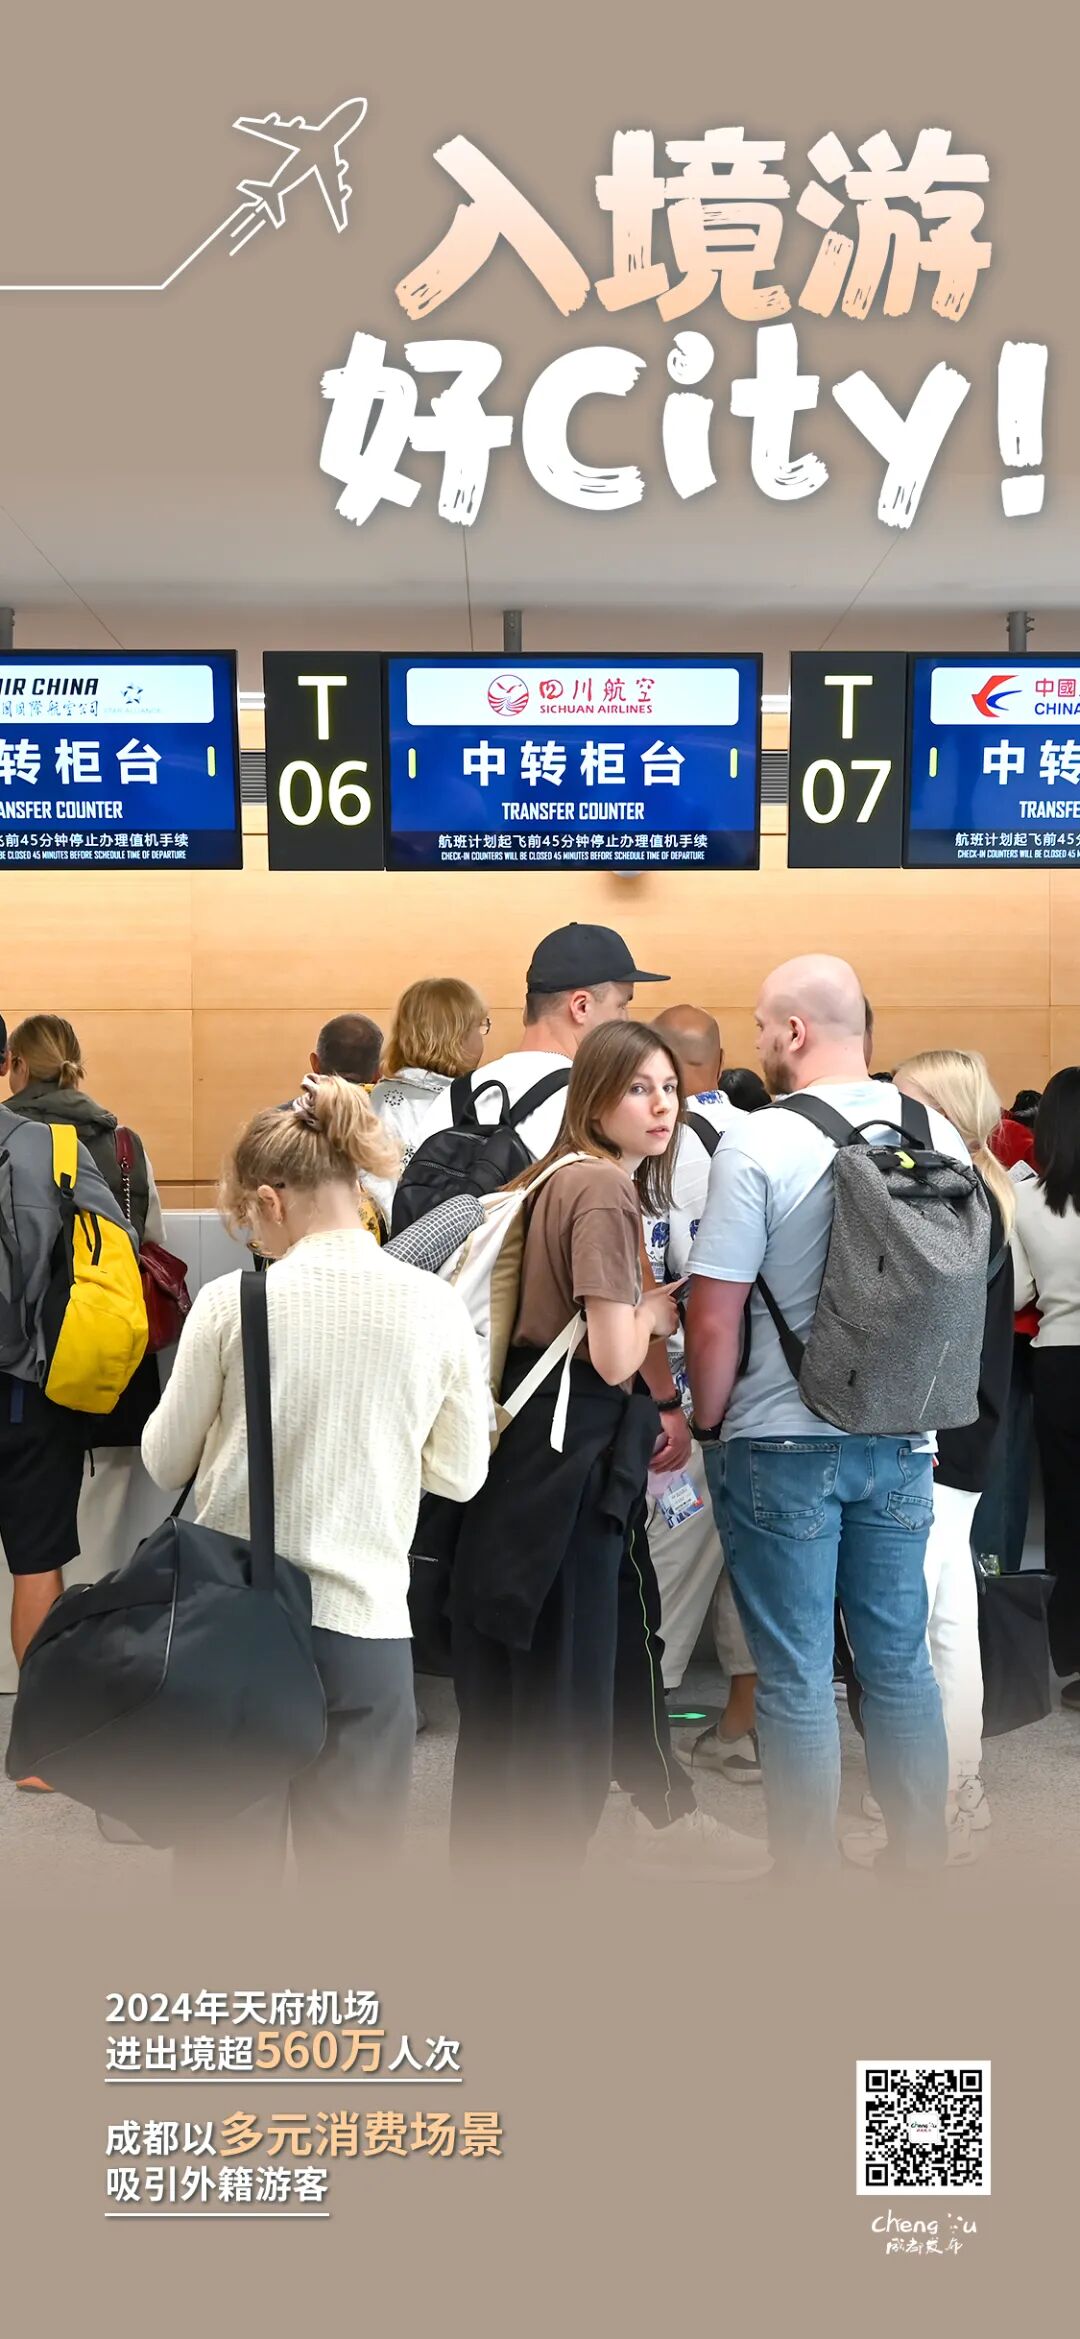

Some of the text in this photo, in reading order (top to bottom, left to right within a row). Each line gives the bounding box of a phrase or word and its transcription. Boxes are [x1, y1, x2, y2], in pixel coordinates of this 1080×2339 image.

[0, 678, 99, 696] IR CHINA
[539, 677, 655, 703] 四川航空
[298, 675, 347, 740] T
[539, 704, 653, 714] SICHUAN AIRLINES
[824, 675, 873, 739] T
[1034, 702, 1080, 716] CHINA
[0, 737, 162, 785] 转柜台
[463, 739, 686, 787] 中转柜台
[982, 739, 1080, 785] 中转
[278, 760, 371, 826] 06
[802, 759, 892, 824] 07
[56, 800, 123, 819] COUNTER
[501, 802, 645, 820] TRANSFER COUNTER
[1019, 800, 1080, 819] TRANSFE
[438, 833, 708, 849] 航班计划起飞前45分钟停止办理值机手续
[954, 832, 1080, 847] 航班计划起飞前45
[7, 850, 31, 860] CLOSED
[32, 850, 41, 860] 45
[42, 850, 68, 860] MINUTES
[69, 850, 93, 860] BEFORE
[94, 850, 125, 860] SCHEDULE
[127, 850, 141, 860] TIME
[141, 850, 150, 860] OF
[151, 850, 186, 860] DEPARTURE
[441, 851, 705, 861] CHECK-IN COUNTERS WILL BE CLOSED 45 MINUTES BEFORE SCHEDULE TIME OF DEPARTURE
[957, 849, 986, 859] CHECK-IN
[987, 849, 1019, 859] COUNTERS
[1019, 849, 1033, 859] WILL
[1034, 849, 1043, 859] BE
[1043, 849, 1067, 859] CLOSED
[1067, 849, 1076, 859] 45
